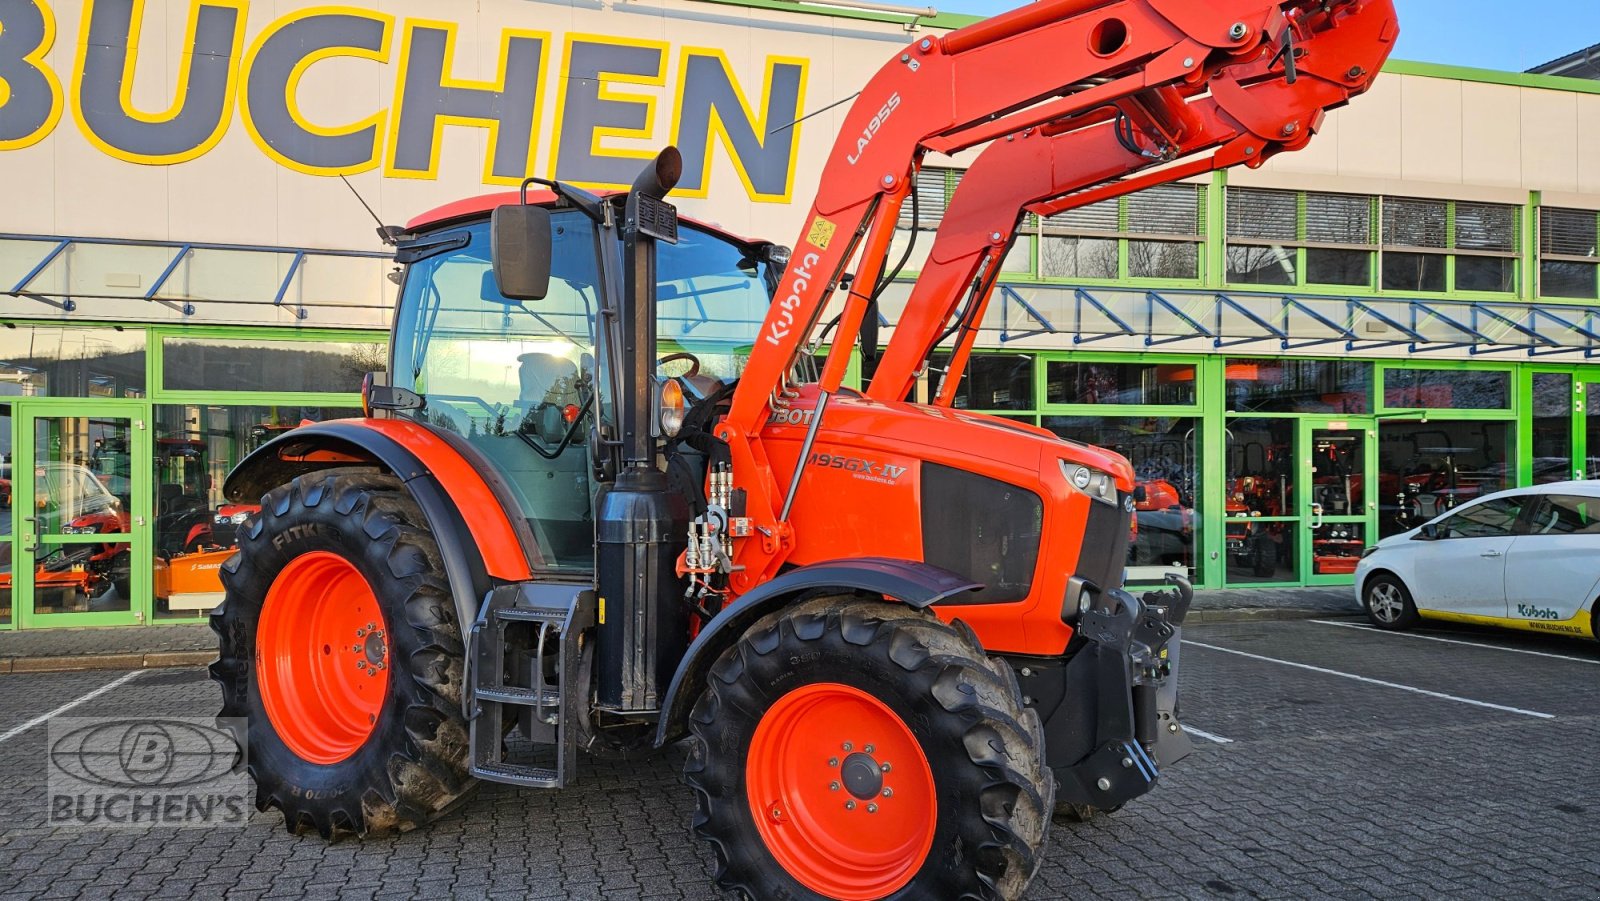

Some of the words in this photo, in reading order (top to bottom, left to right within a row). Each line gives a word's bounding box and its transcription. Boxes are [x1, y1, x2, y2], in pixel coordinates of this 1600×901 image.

[847, 92, 901, 165] LA1955
[766, 252, 820, 346] Kubota
[1518, 604, 1558, 619] Kubota
